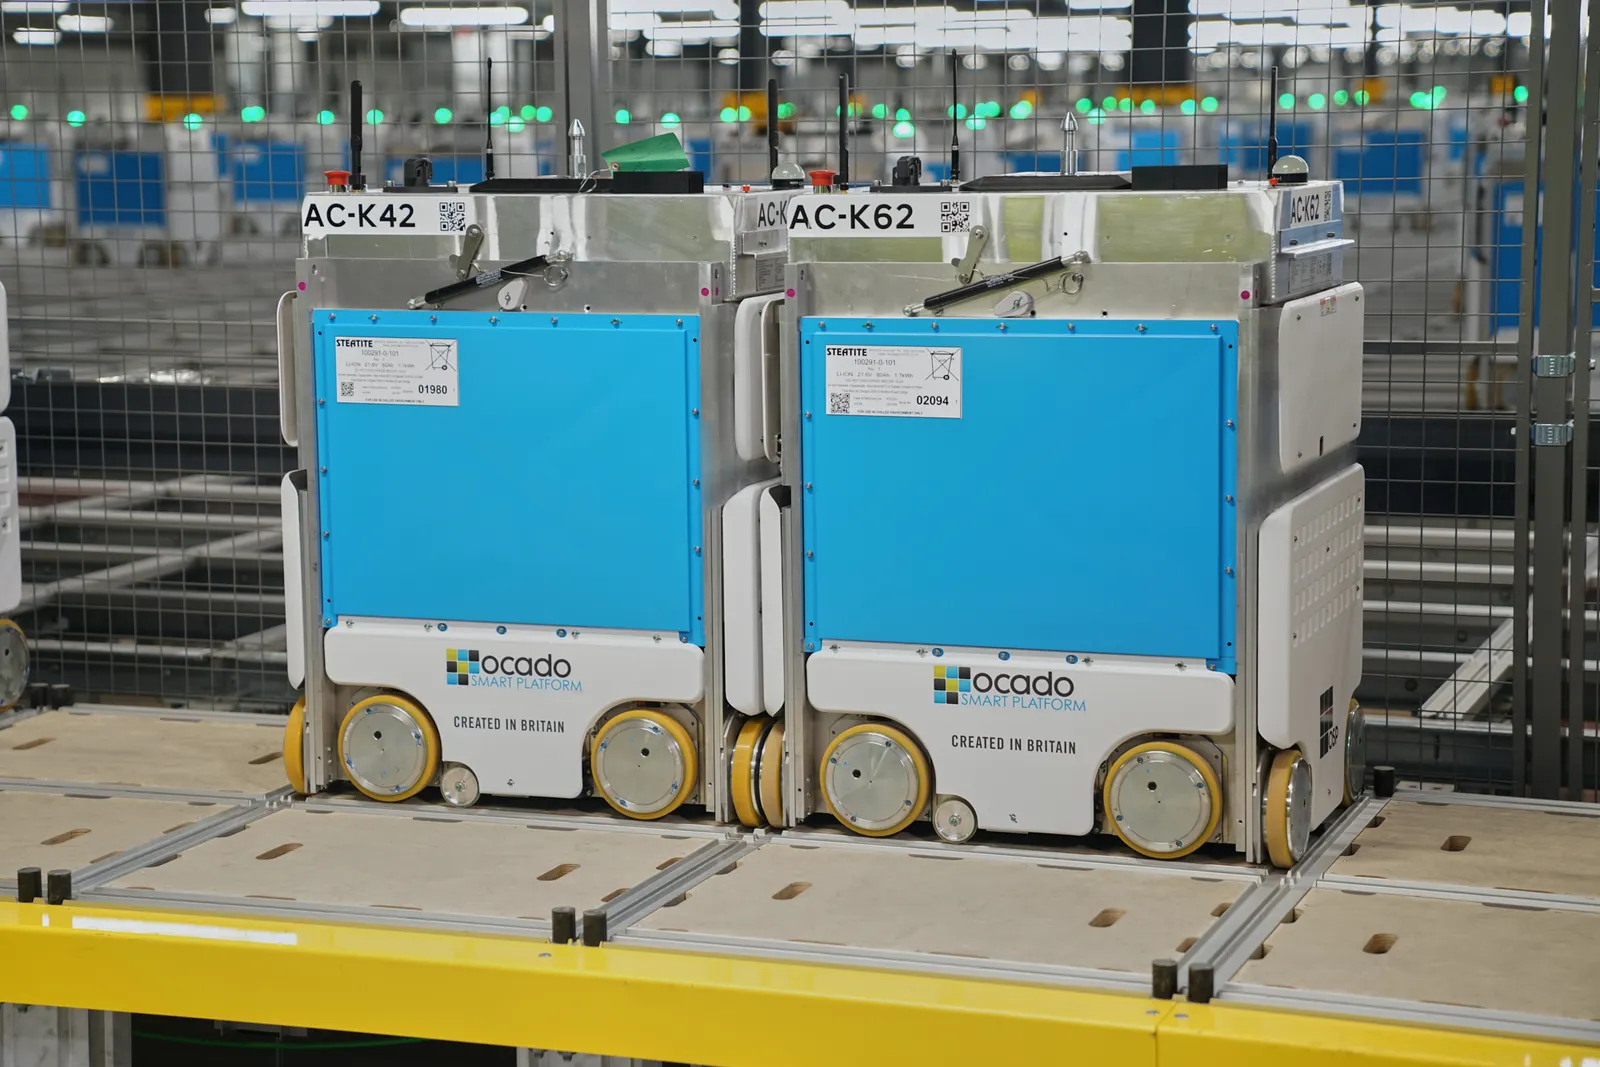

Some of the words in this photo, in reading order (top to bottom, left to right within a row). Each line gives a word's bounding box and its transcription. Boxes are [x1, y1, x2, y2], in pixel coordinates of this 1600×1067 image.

[304, 203, 416, 228] AC-K42
[757, 200, 787, 228] AC-K
[789, 203, 915, 229] AC-K62
[1290, 194, 1320, 223] AC-K62
[336, 339, 373, 348] STEATITE
[826, 347, 867, 356] STEATITE
[418, 384, 448, 394] 01980
[916, 395, 949, 406] 02094
[481, 653, 571, 678] ocado
[471, 675, 512, 688] SMART
[517, 677, 582, 691] PLATFORM
[973, 671, 1074, 697] ocado
[961, 694, 1008, 708] SMART
[1012, 697, 1086, 712] PLATFORM
[453, 715, 500, 730] CREATED
[505, 718, 516, 730] IN
[521, 719, 565, 733] BRITAIN
[951, 734, 1004, 750] CREATED
[1010, 738, 1022, 751] IN
[1027, 739, 1076, 754] BRITAIN
